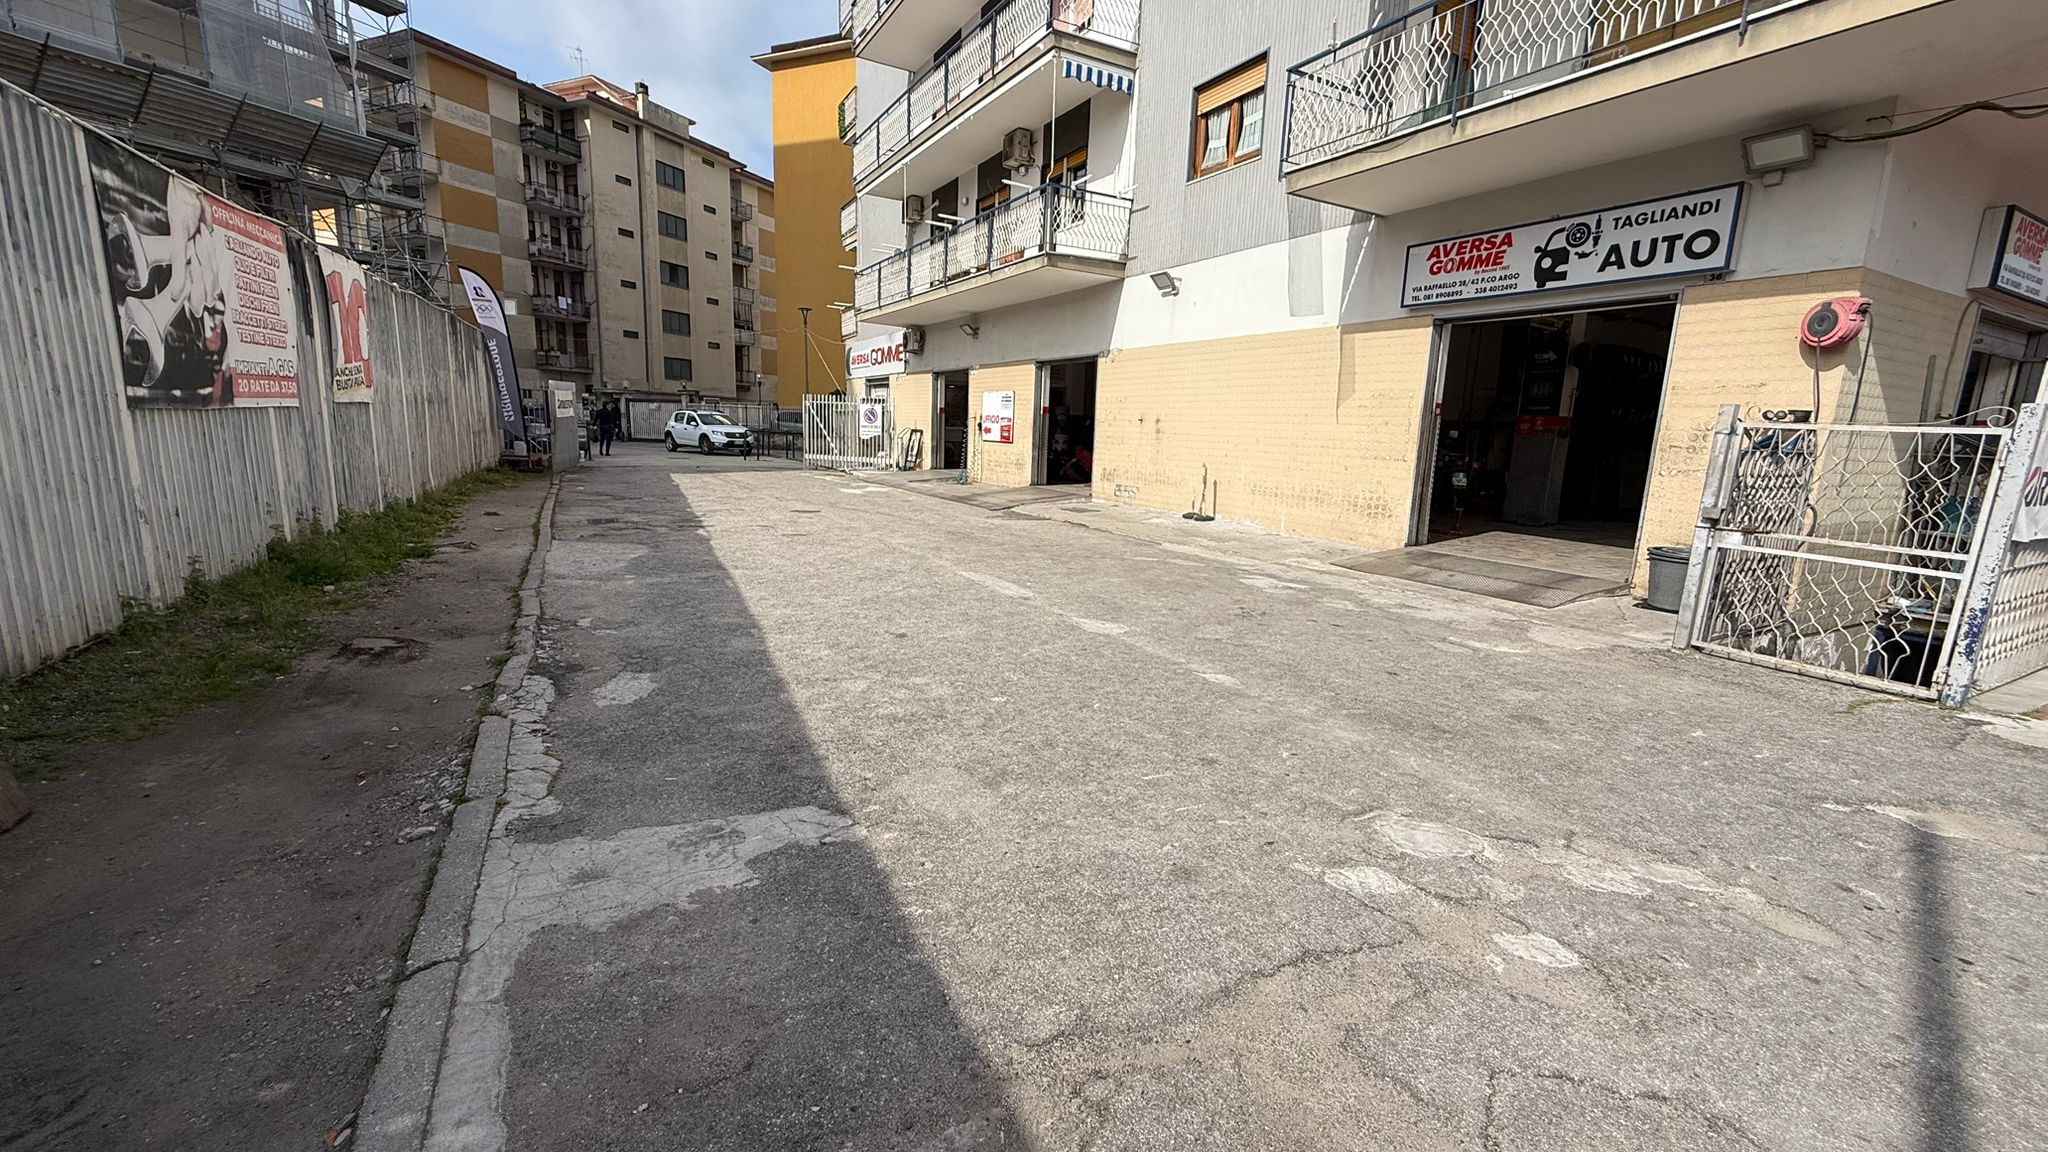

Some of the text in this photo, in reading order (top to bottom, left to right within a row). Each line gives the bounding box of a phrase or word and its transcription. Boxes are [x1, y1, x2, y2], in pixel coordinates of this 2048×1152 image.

[212, 205, 246, 230] OFFICINA
[1612, 198, 1721, 231] TAGLIANDI
[1426, 232, 1513, 261] AVERSA
[1597, 228, 1721, 273] AUTO
[1429, 249, 1507, 276] GOMME
[1424, 281, 1457, 292] RAFFAELLO
[1458, 278, 1479, 288] 28/42
[1498, 272, 1520, 281] ARGO
[1474, 286, 1487, 295] 338
[1488, 282, 1518, 293] 4012493
[851, 343, 904, 366] AVERSA GOMME
[269, 357, 278, 377] A
[277, 358, 295, 379] GAS
[238, 378, 249, 392] 20
[250, 379, 270, 393] RATE
[270, 380, 280, 393] DA
